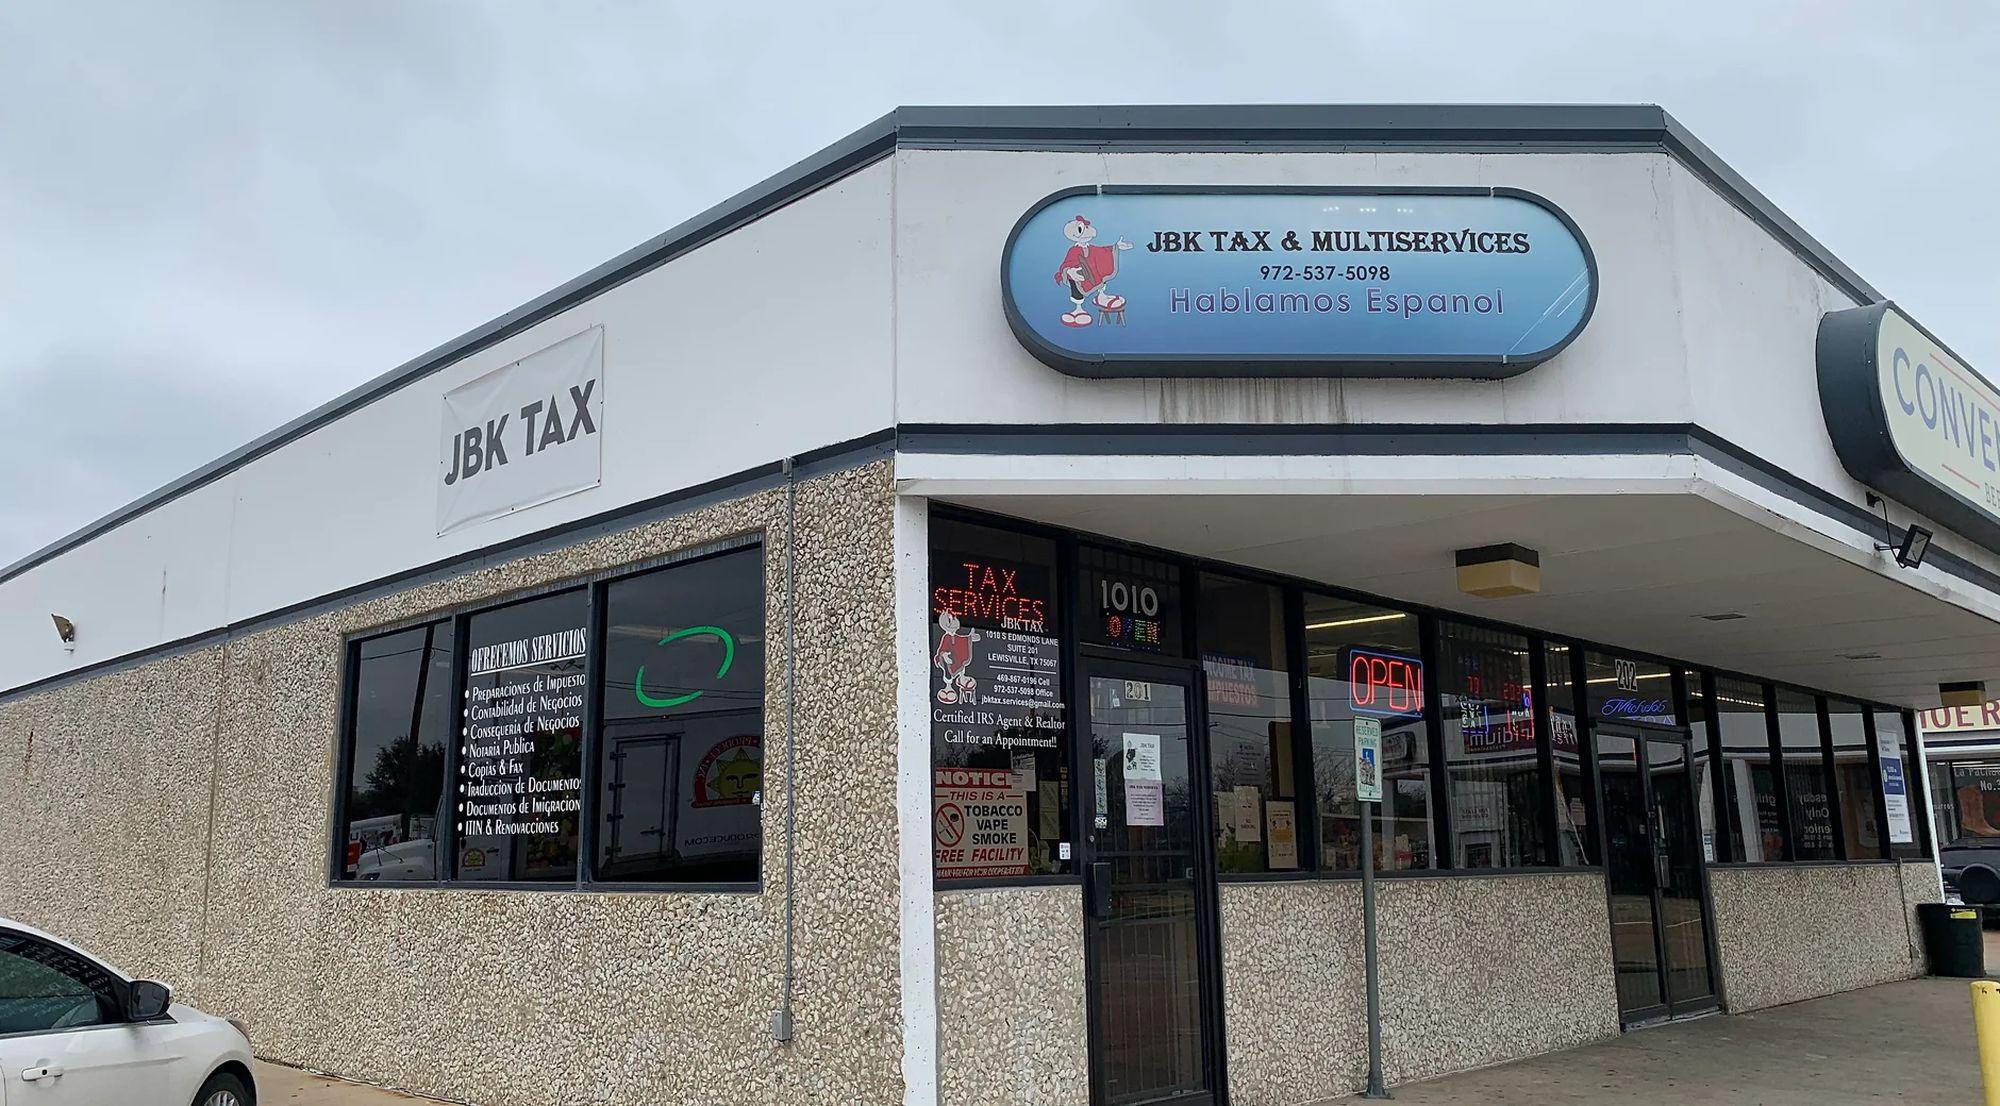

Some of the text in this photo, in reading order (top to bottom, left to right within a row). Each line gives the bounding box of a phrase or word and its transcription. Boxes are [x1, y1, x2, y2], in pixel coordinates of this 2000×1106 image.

[1146, 228, 1531, 254] JBK TAX & MULTISERVICES
[1259, 264, 1391, 281] 972-537-5098
[1169, 286, 1504, 319] Hablamos Espanol
[444, 378, 597, 486] JBK TAX
[963, 562, 1017, 595] TAX
[933, 587, 1044, 624] SERVICES
[1101, 579, 1159, 617] 1010
[1000, 615, 1044, 634] JBK TAX
[1001, 632, 1007, 640] S
[1007, 632, 1041, 645] EDMONDS
[1041, 637, 1059, 647] LANE
[471, 627, 587, 673] OFRECEMOS SERVICIOS
[1006, 643, 1038, 655] SUITE 201
[988, 652, 1029, 666] LEWISVILLE,
[1030, 656, 1039, 666] TX
[533, 675, 543, 693] de
[1037, 676, 1050, 686] Cell
[1352, 656, 1421, 712] OPEN
[1615, 659, 1638, 691] 202
[1035, 686, 1054, 698] Office
[1126, 682, 1150, 700] 201
[526, 696, 537, 714] de
[523, 716, 534, 734] de
[933, 708, 1066, 730] Certified IRS Agent & Realtor
[944, 729, 1057, 749] Call for an Appointment!!
[499, 758, 506, 776] &
[515, 776, 525, 794] de
[518, 796, 529, 814] de
[949, 791, 1006, 801] THIS IS A
[963, 805, 1023, 817] TOBACCO
[465, 819, 483, 836] ITIN
[485, 818, 493, 836] &
[976, 819, 1009, 831] VAPE
[971, 832, 1017, 845] SMOKE
[970, 847, 1025, 862] FACILITY
